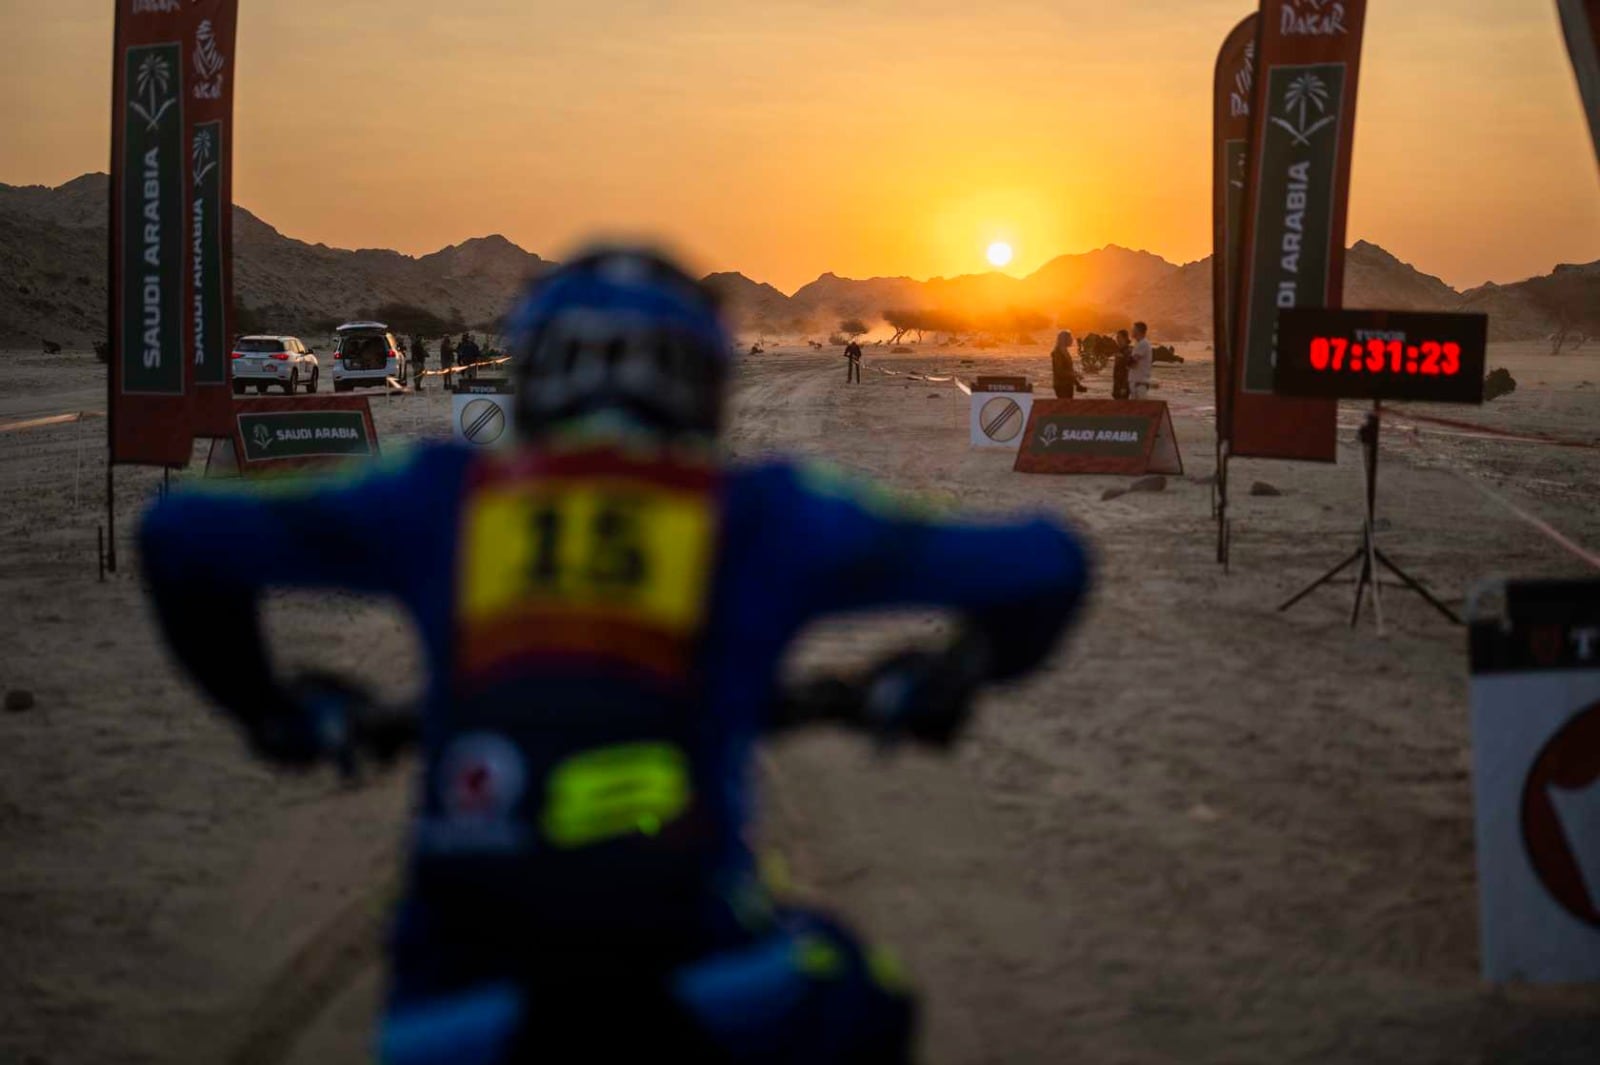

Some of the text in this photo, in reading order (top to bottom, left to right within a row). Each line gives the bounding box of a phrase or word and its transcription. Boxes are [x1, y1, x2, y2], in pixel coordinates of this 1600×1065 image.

[1280, 3, 1348, 37] DAKAR
[1281, 160, 1311, 273] ARABIA
[143, 147, 161, 369] SAUDI ARABIA
[1309, 337, 1461, 376] 07:31:23
[275, 427, 358, 440] SAUDI ARABIA
[1061, 429, 1139, 442] SAUDI ARABIA
